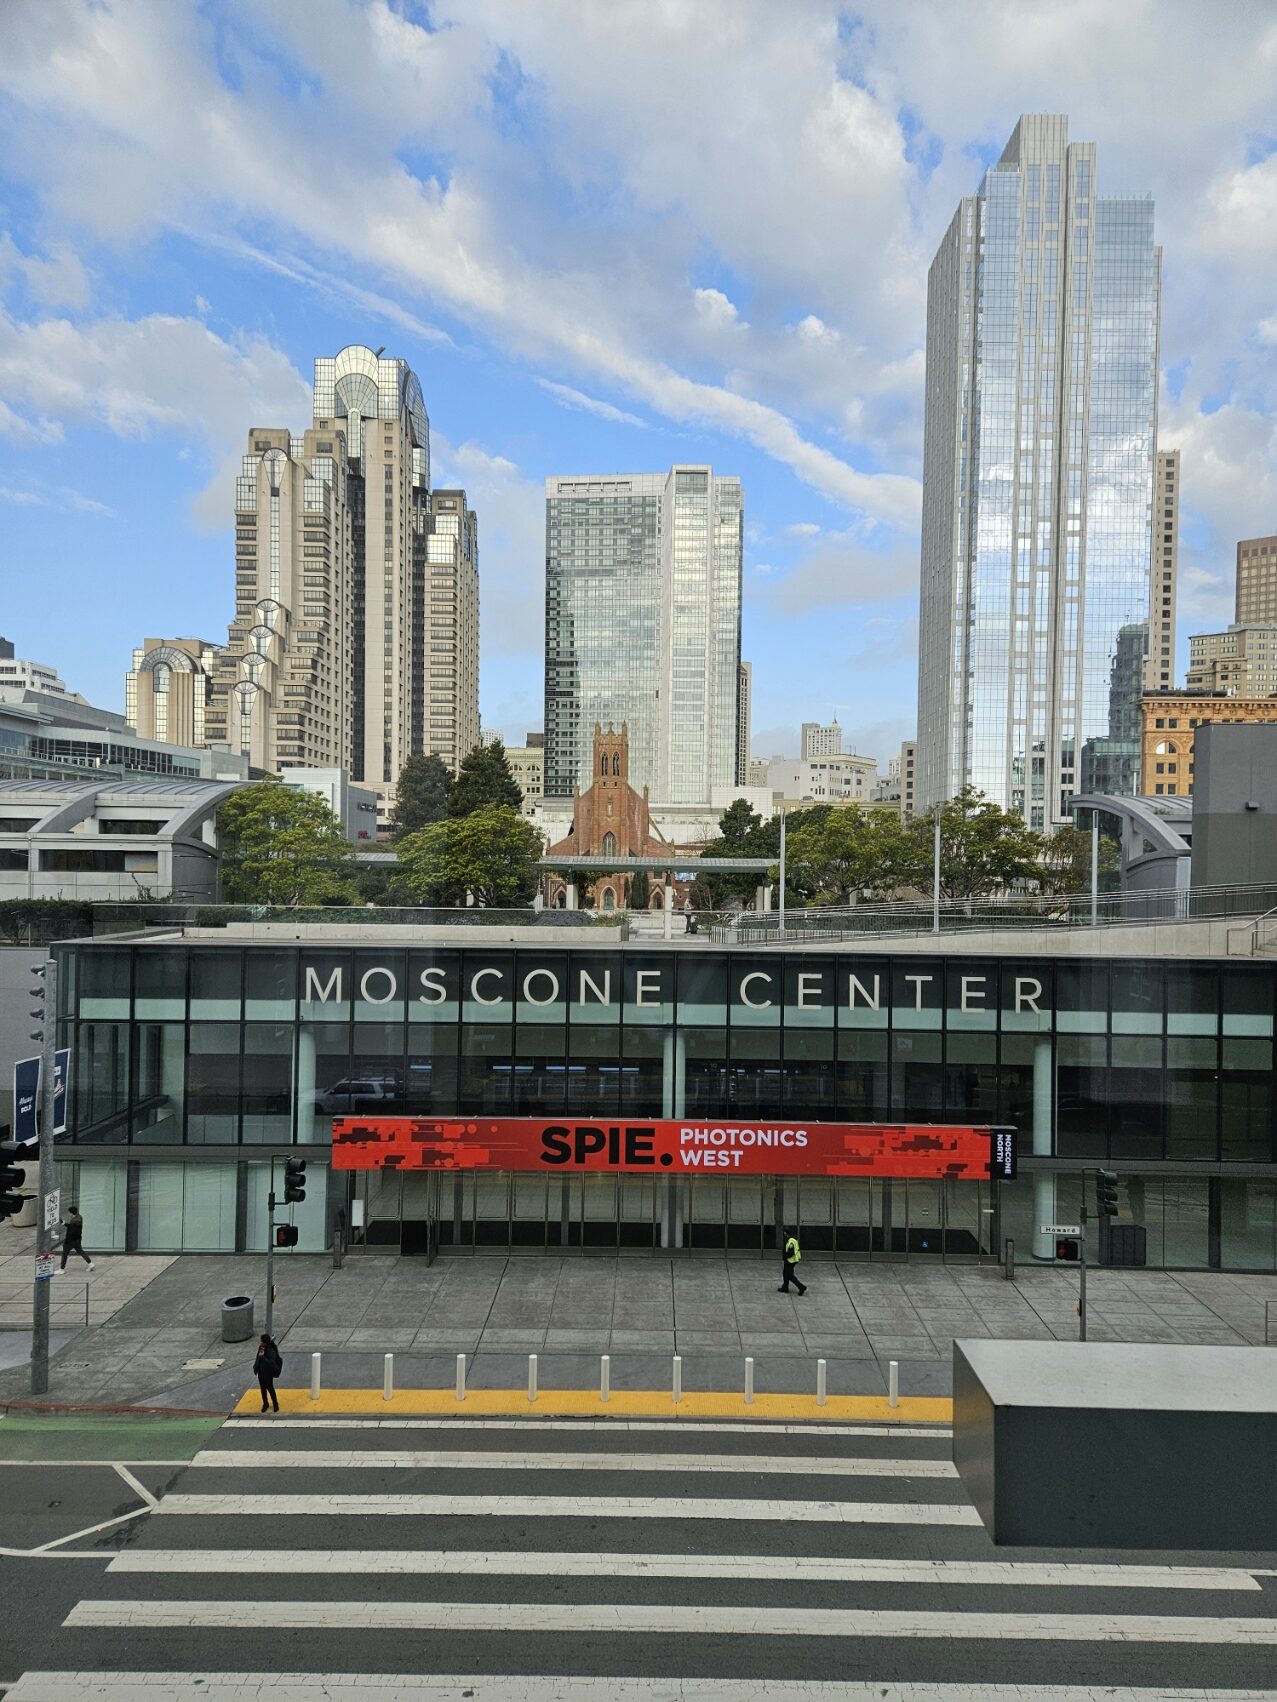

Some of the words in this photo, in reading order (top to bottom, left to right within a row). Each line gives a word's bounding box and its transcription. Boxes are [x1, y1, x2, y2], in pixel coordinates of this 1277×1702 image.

[304, 966, 662, 1008] MOSCONE
[739, 971, 1043, 1014] CENTER
[540, 1126, 673, 1166] SPIE.
[679, 1128, 808, 1147] PHOTONICS
[996, 1134, 1004, 1162] NORTH
[1004, 1134, 1012, 1175] MOSCONE
[679, 1149, 744, 1167] WEST
